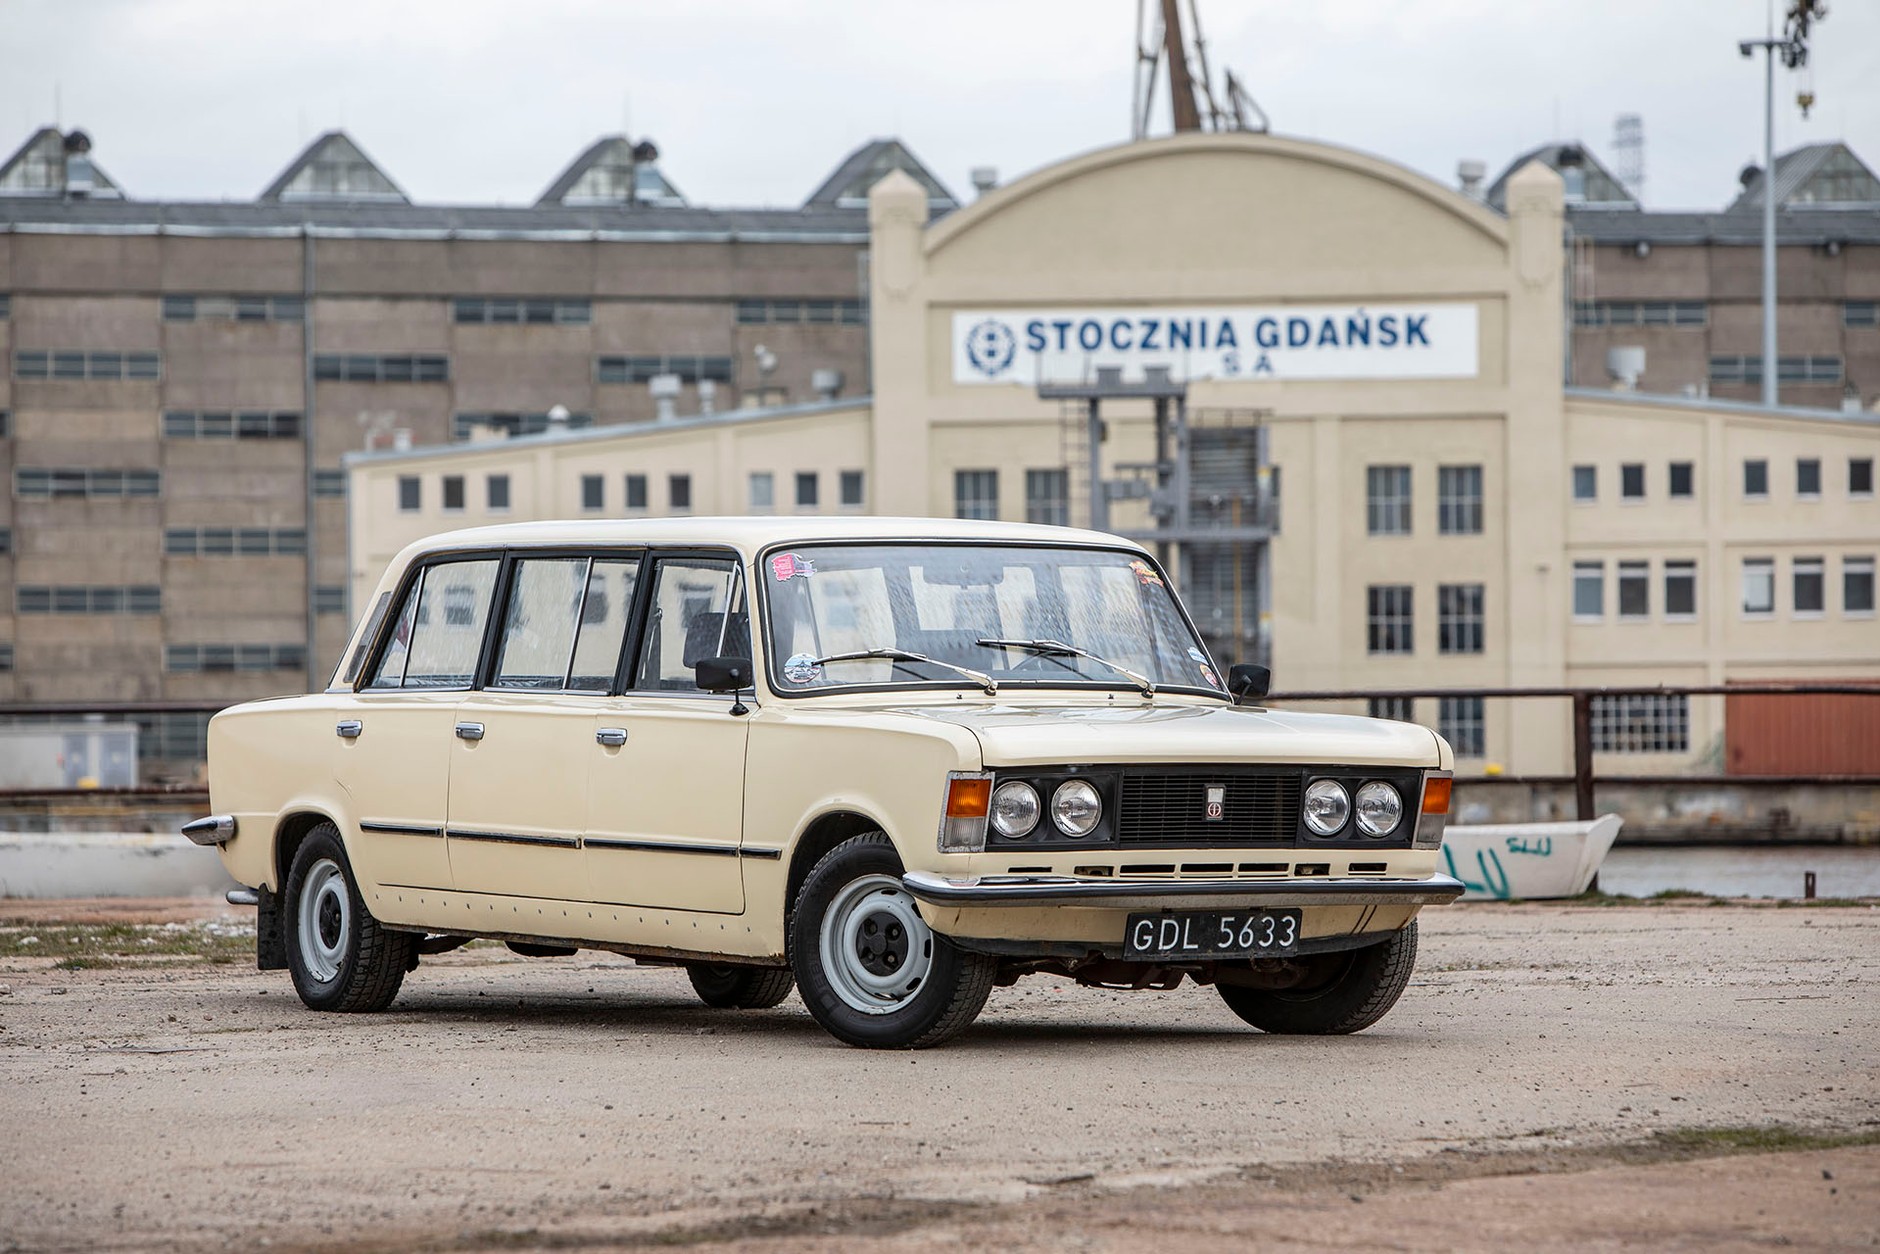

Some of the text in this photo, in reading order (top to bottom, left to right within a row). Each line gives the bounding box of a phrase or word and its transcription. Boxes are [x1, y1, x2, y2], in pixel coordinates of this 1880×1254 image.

[1027, 308, 1430, 351] STOCZNIA GDAŃSK
[1133, 915, 1297, 951] GDL 5633
